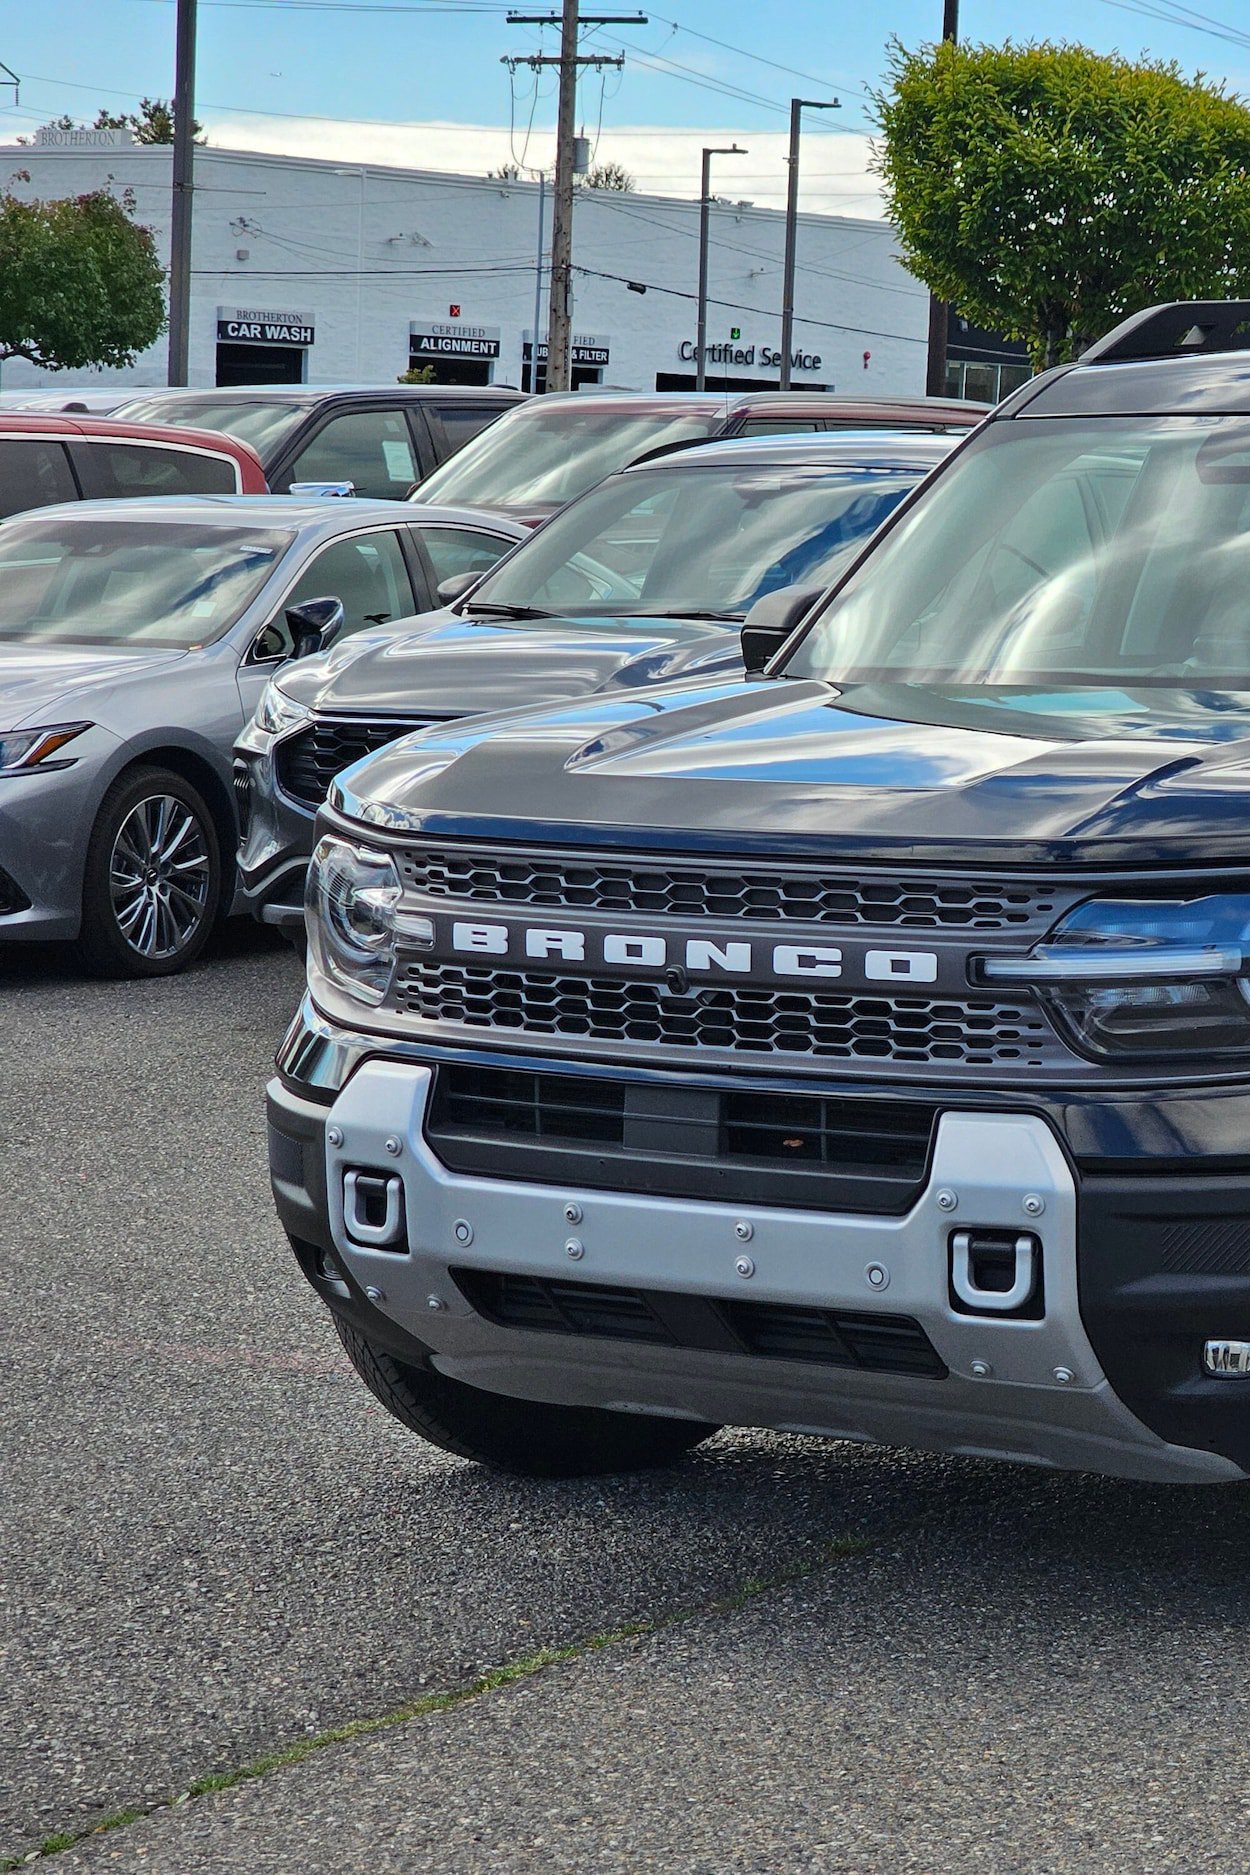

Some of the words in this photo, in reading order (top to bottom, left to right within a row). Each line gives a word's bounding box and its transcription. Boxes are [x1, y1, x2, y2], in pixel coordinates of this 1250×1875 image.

[41, 130, 115, 146] BROTHERTON
[236, 310, 303, 324] BROTHERTON
[227, 323, 262, 338] CAR
[265, 325, 312, 342] WASH
[432, 325, 486, 338] CERTIFIED
[420, 338, 497, 355] ALIGNMENT
[579, 350, 607, 362] FILTER
[761, 347, 822, 370] Sevice
[453, 921, 938, 983] BRONCO
